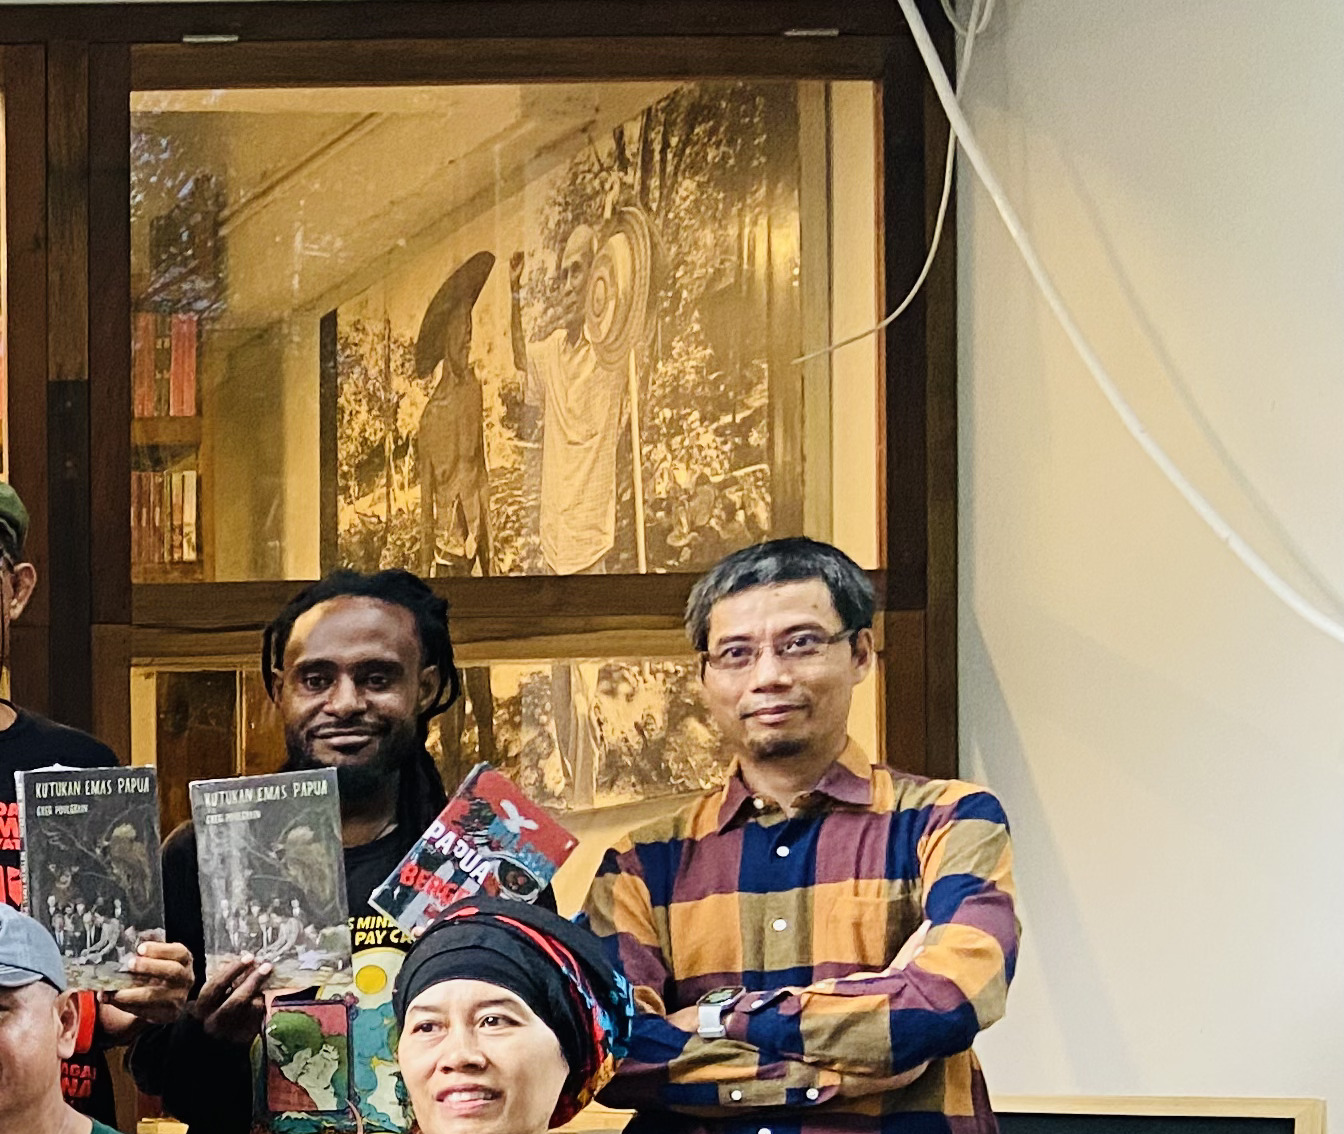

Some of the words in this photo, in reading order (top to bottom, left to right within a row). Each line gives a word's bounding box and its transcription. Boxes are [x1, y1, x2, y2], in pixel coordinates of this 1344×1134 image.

[35, 780, 81, 798] KUTUKAN
[85, 779, 112, 796] EMAS
[117, 777, 150, 793] PAPUA
[204, 789, 254, 807] KUTUKAN
[257, 784, 288, 801] EMAS
[293, 780, 328, 798] PAPUA
[422, 818, 492, 886] PAPUA
[354, 930, 387, 946] PAY
